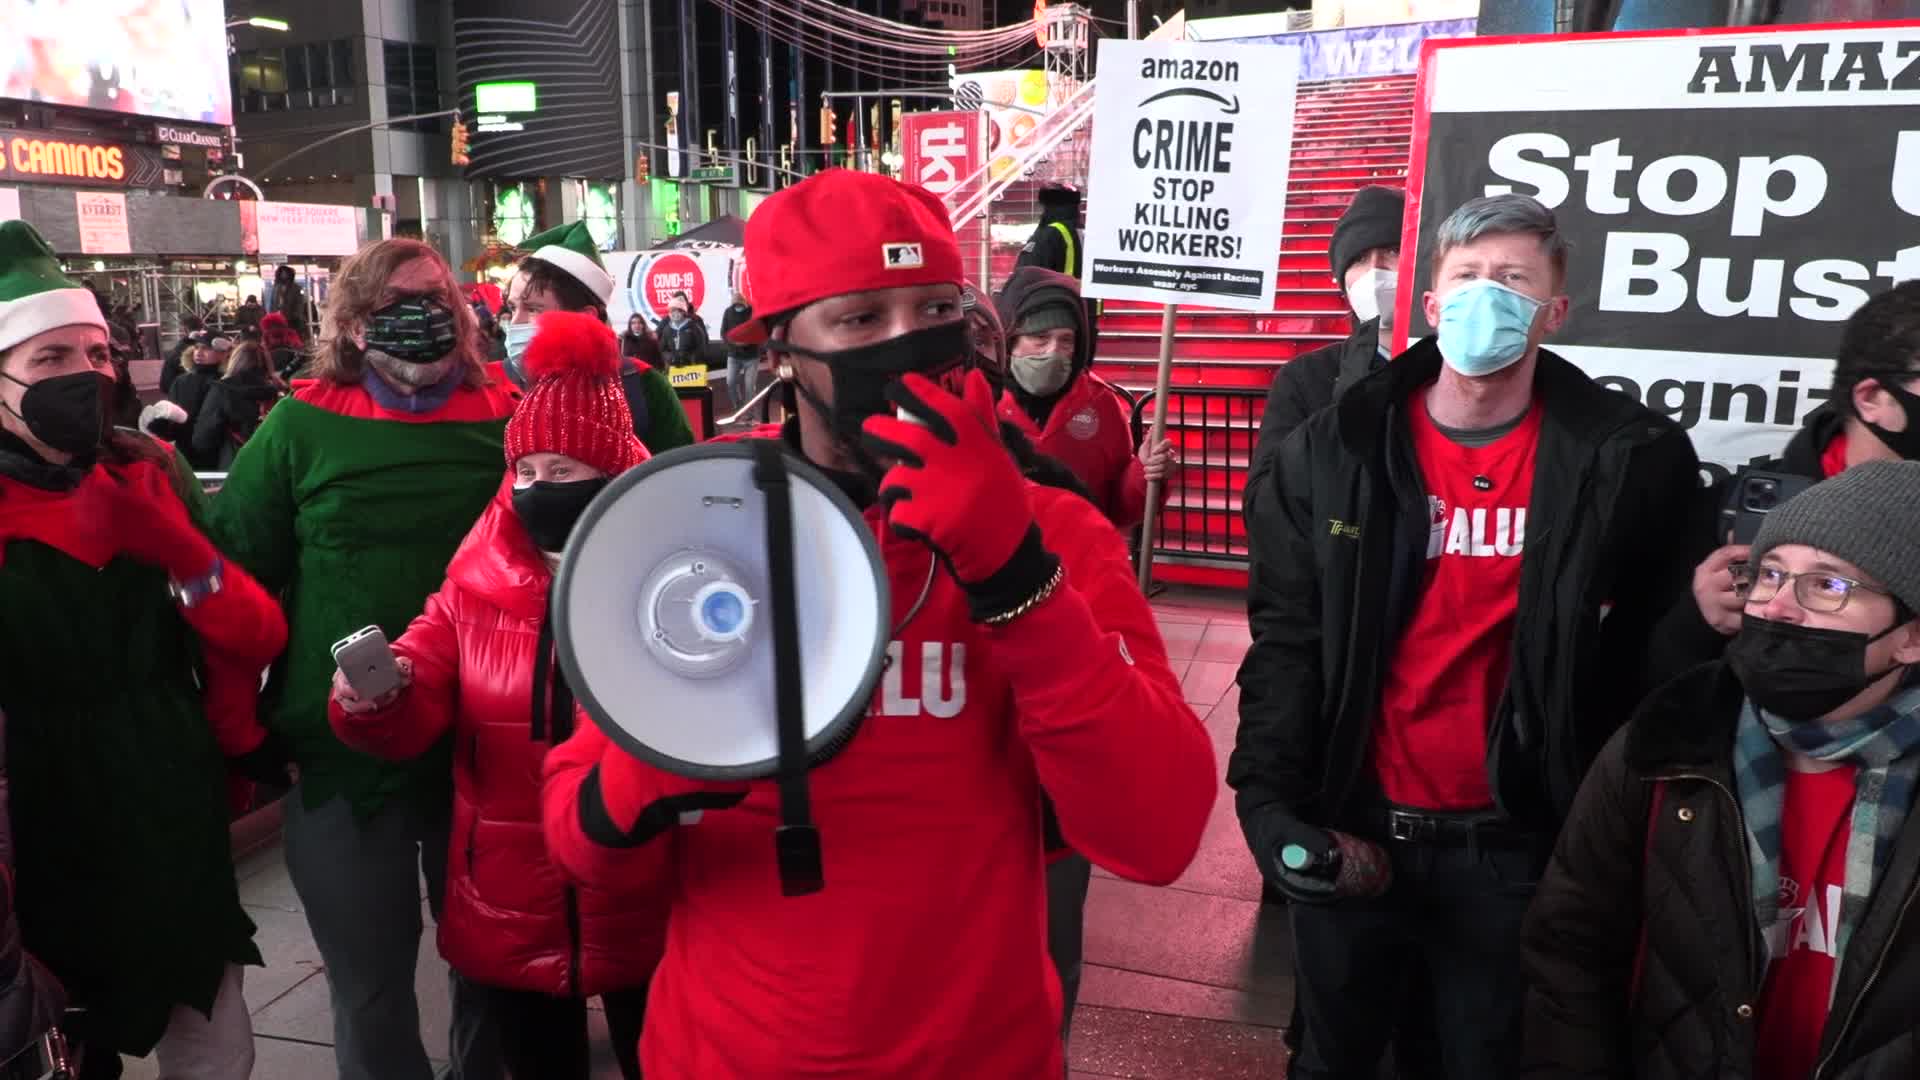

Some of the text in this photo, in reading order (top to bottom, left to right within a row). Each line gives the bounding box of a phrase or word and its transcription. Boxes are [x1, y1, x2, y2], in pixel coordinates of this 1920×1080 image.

[1141, 57, 1239, 82] amazon
[1687, 41, 1920, 93] AMAZ
[11, 138, 124, 179] CAMINOS
[1132, 118, 1234, 173] CRIME
[1153, 177, 1214, 202] STOP
[1484, 133, 1828, 236] Stop
[1134, 203, 1230, 231] KILLING
[1118, 228, 1242, 259] WORKERS!
[653, 272, 694, 288] COVID-19
[1094, 264, 1260, 284] Workers Assembly Against Racism
[1445, 507, 1526, 557] ALU
[866, 640, 966, 718] LU
